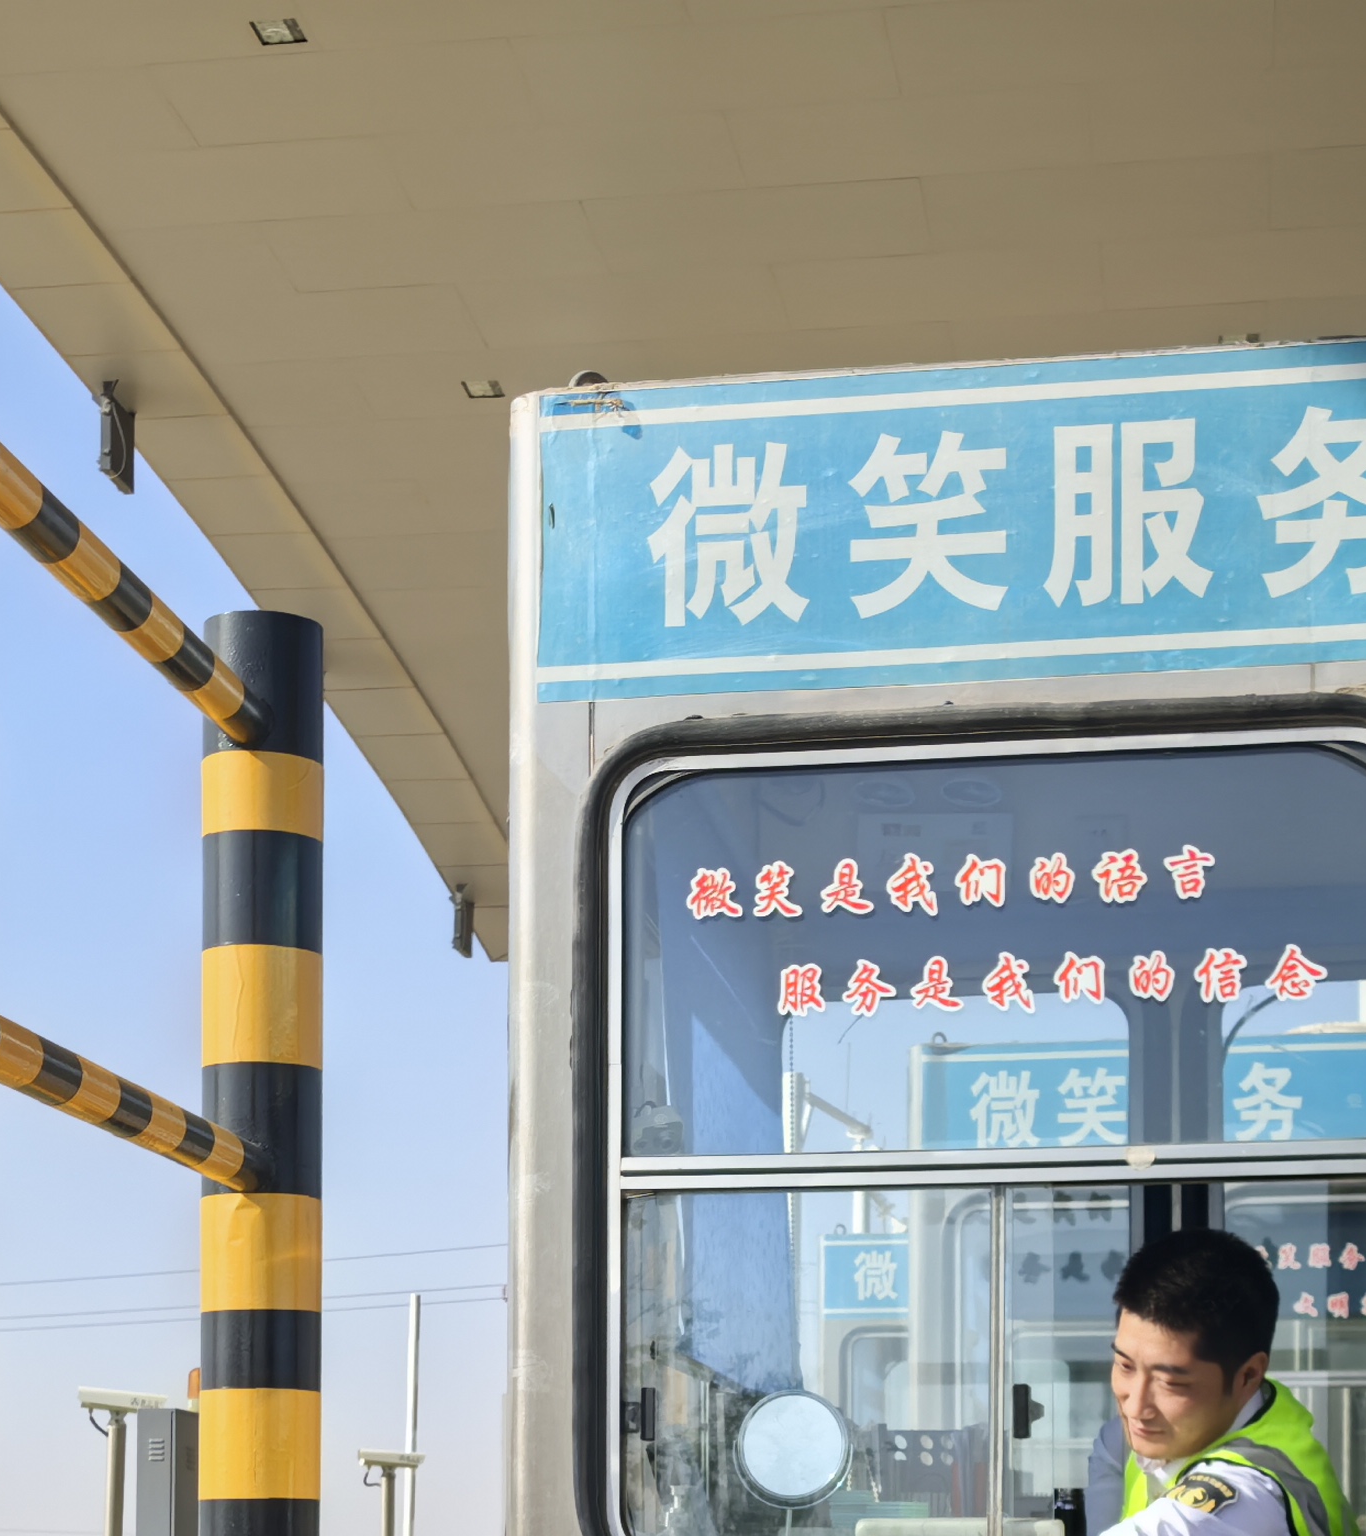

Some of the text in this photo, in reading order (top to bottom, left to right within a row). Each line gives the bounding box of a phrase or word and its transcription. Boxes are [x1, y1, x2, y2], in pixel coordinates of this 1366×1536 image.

[686, 844, 1215, 921] 微笑是我们的语言
[777, 944, 1327, 1018] 服务是我们的信念
